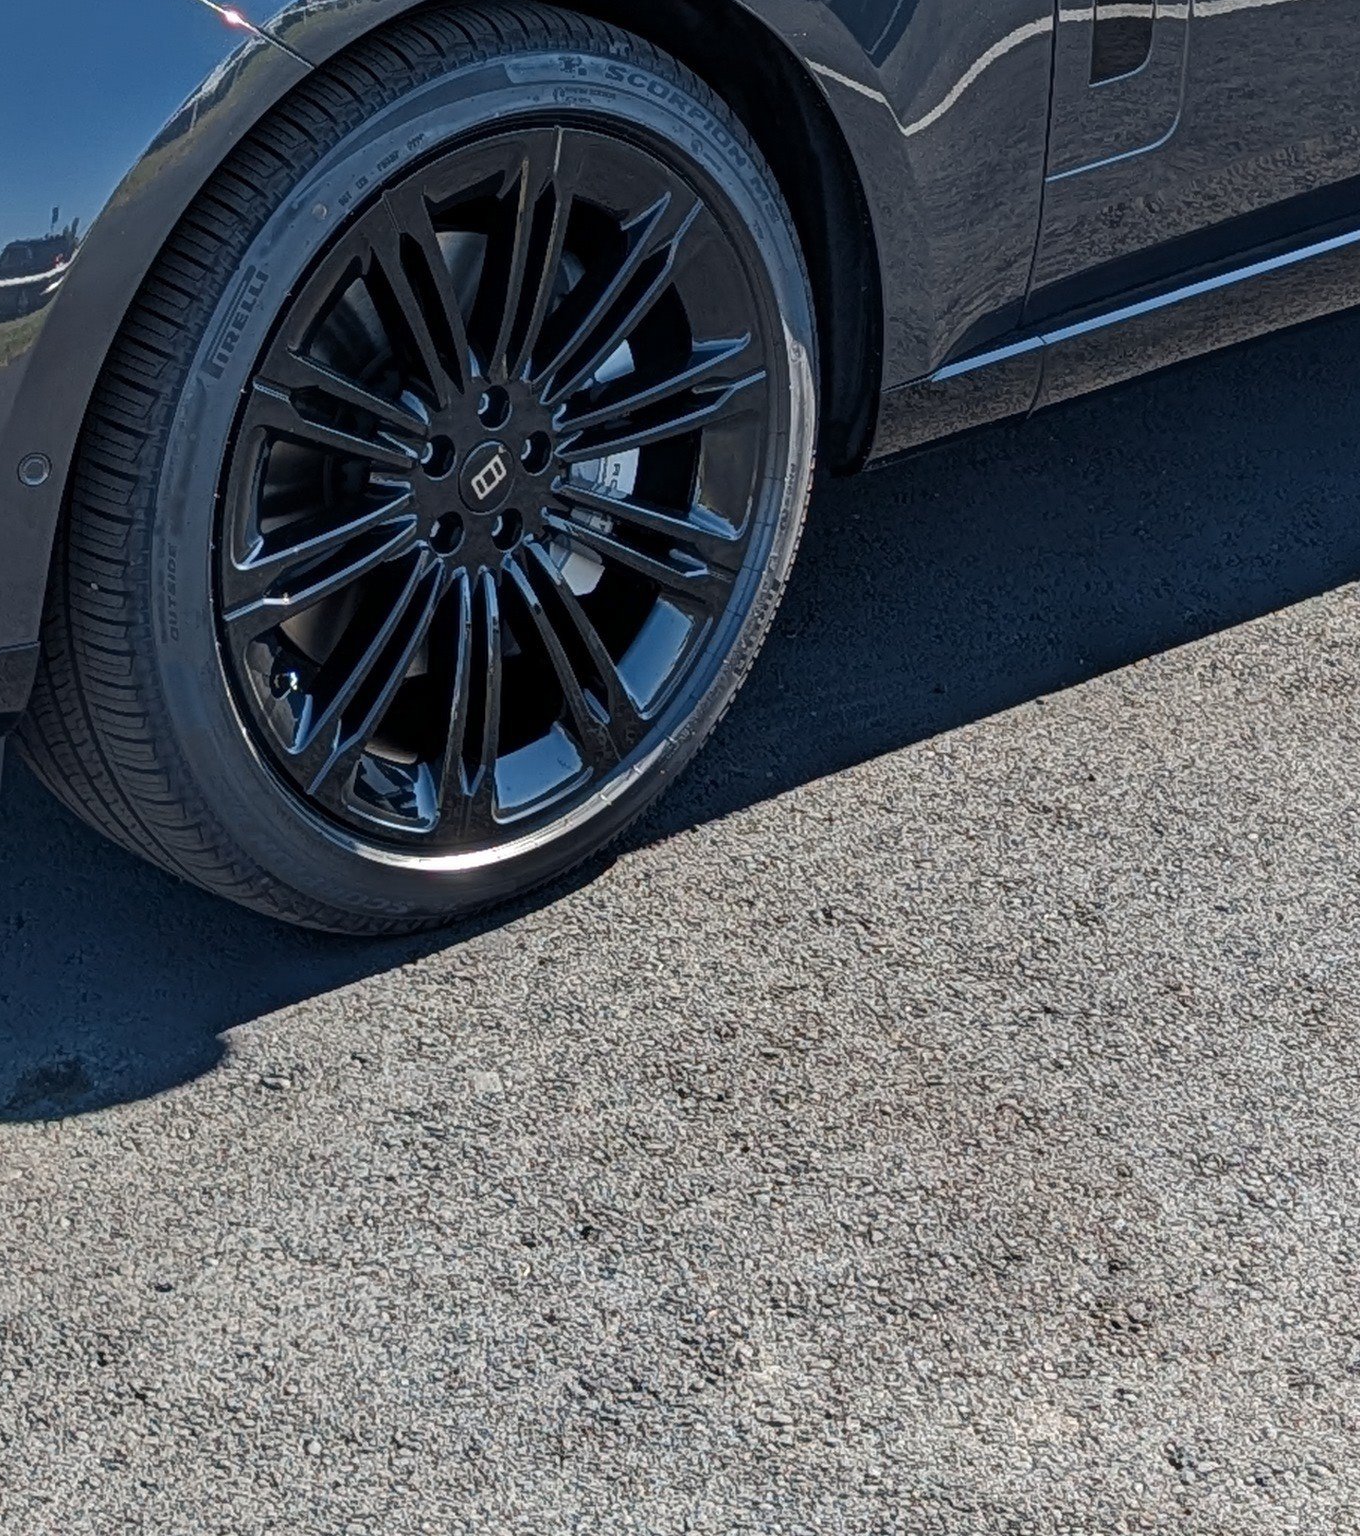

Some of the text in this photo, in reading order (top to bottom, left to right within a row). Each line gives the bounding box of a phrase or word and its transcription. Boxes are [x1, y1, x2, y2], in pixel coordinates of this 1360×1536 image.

[605, 64, 747, 168] SCORPION
[201, 265, 269, 380] PIRELLI
[167, 543, 179, 641] OUTSIDE
